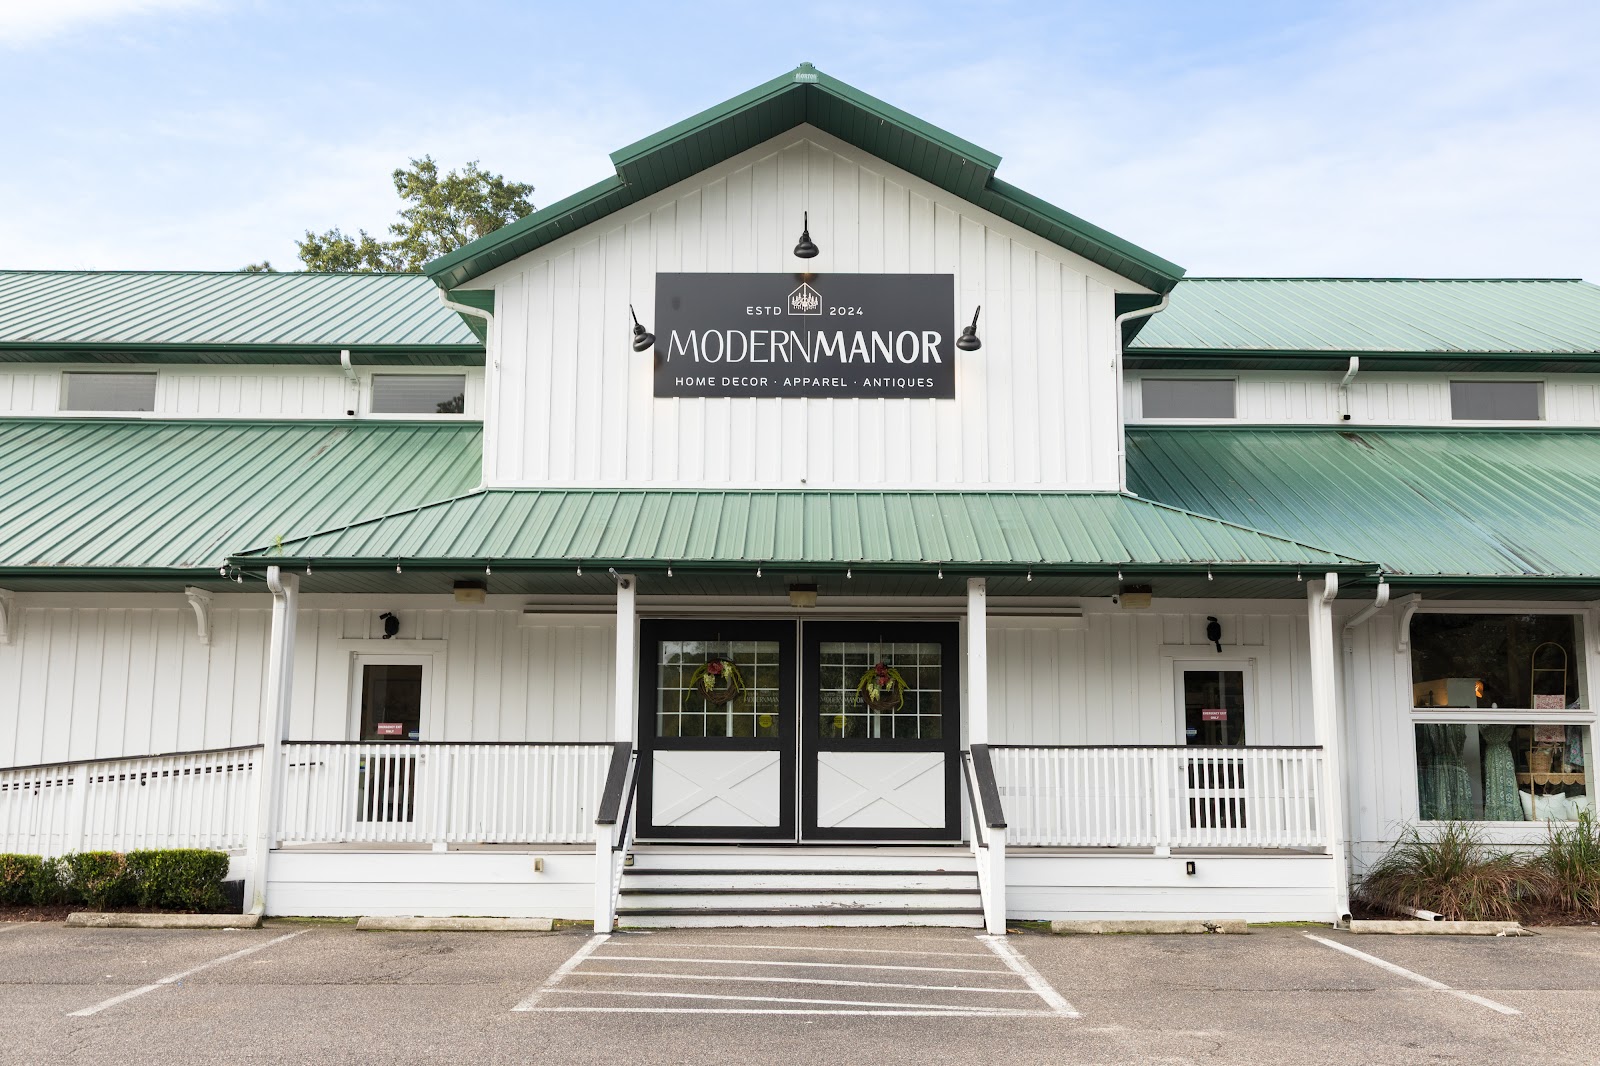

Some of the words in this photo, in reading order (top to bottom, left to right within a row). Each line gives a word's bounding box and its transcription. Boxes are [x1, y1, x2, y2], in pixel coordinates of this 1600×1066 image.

[746, 305, 782, 316] ESTD
[829, 306, 864, 316] 2024
[666, 328, 943, 364] MODERNMANOR
[675, 376, 716, 387] HOME
[721, 376, 768, 387] DECOR
[783, 377, 848, 387] APPAREL
[862, 377, 934, 389] ANTIQUES
